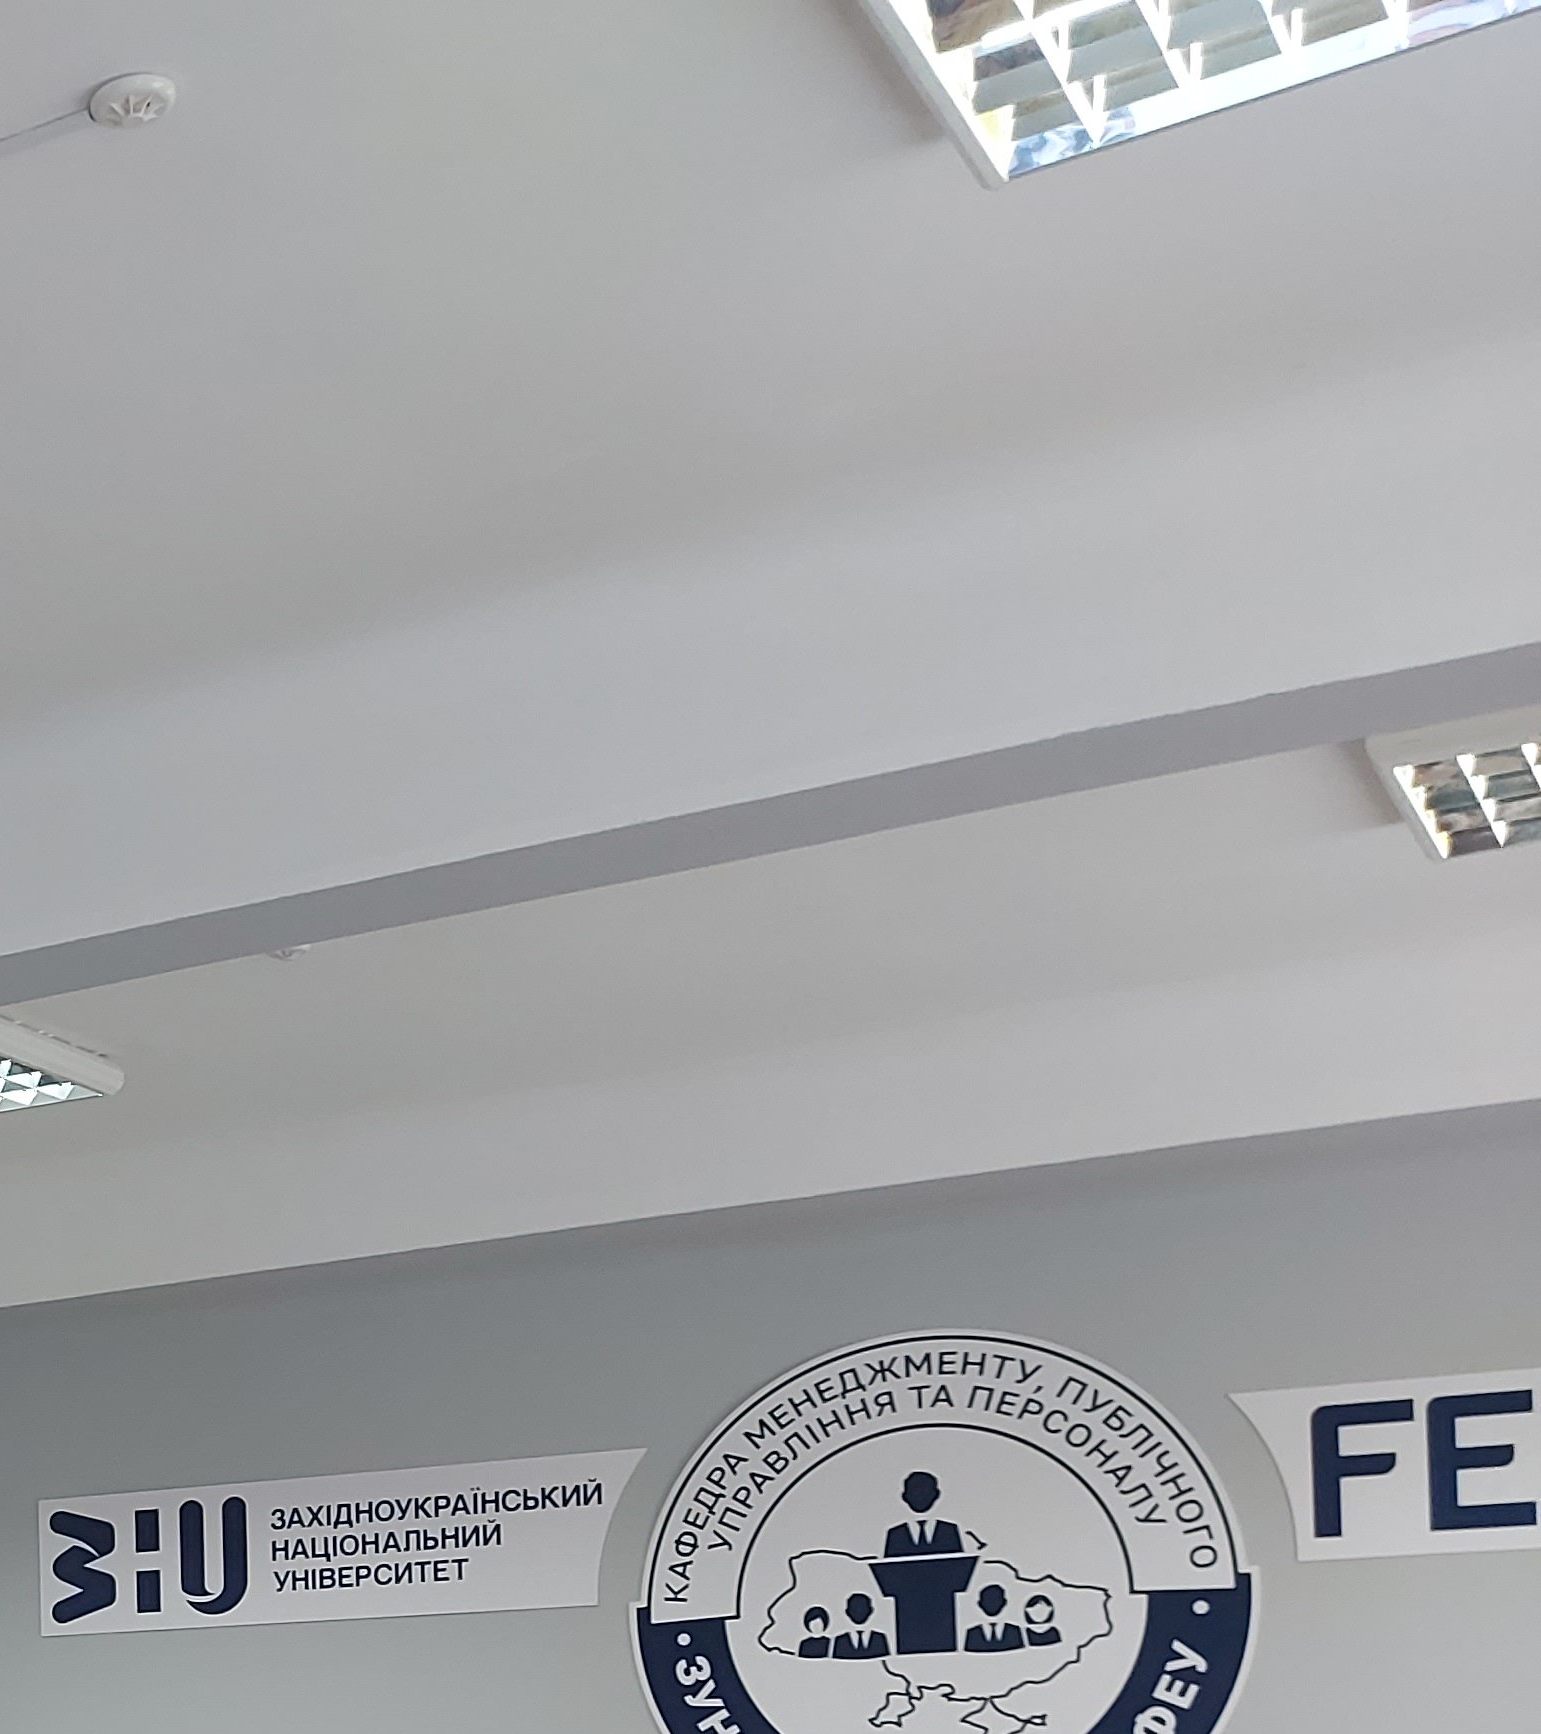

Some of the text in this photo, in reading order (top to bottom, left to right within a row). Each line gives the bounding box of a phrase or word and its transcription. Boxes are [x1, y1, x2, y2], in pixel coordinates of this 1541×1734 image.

[271, 1478, 604, 1531] ЗАХІДНОУКРАЇНСЬКИЙ
[664, 1351, 1218, 1602] КАФЕДРА МЕНЕДЖМЕНТУ, ПУБЛІЧНОГО
[708, 1385, 1168, 1551] УПРАВЛІННЯ ТА ПЕРСОНАЛУ
[1310, 1389, 1537, 1538] FE
[271, 1519, 502, 1562] НАЦІОНАЛЬНИЙ
[273, 1558, 469, 1593] УНІВЕРСИТЕТ
